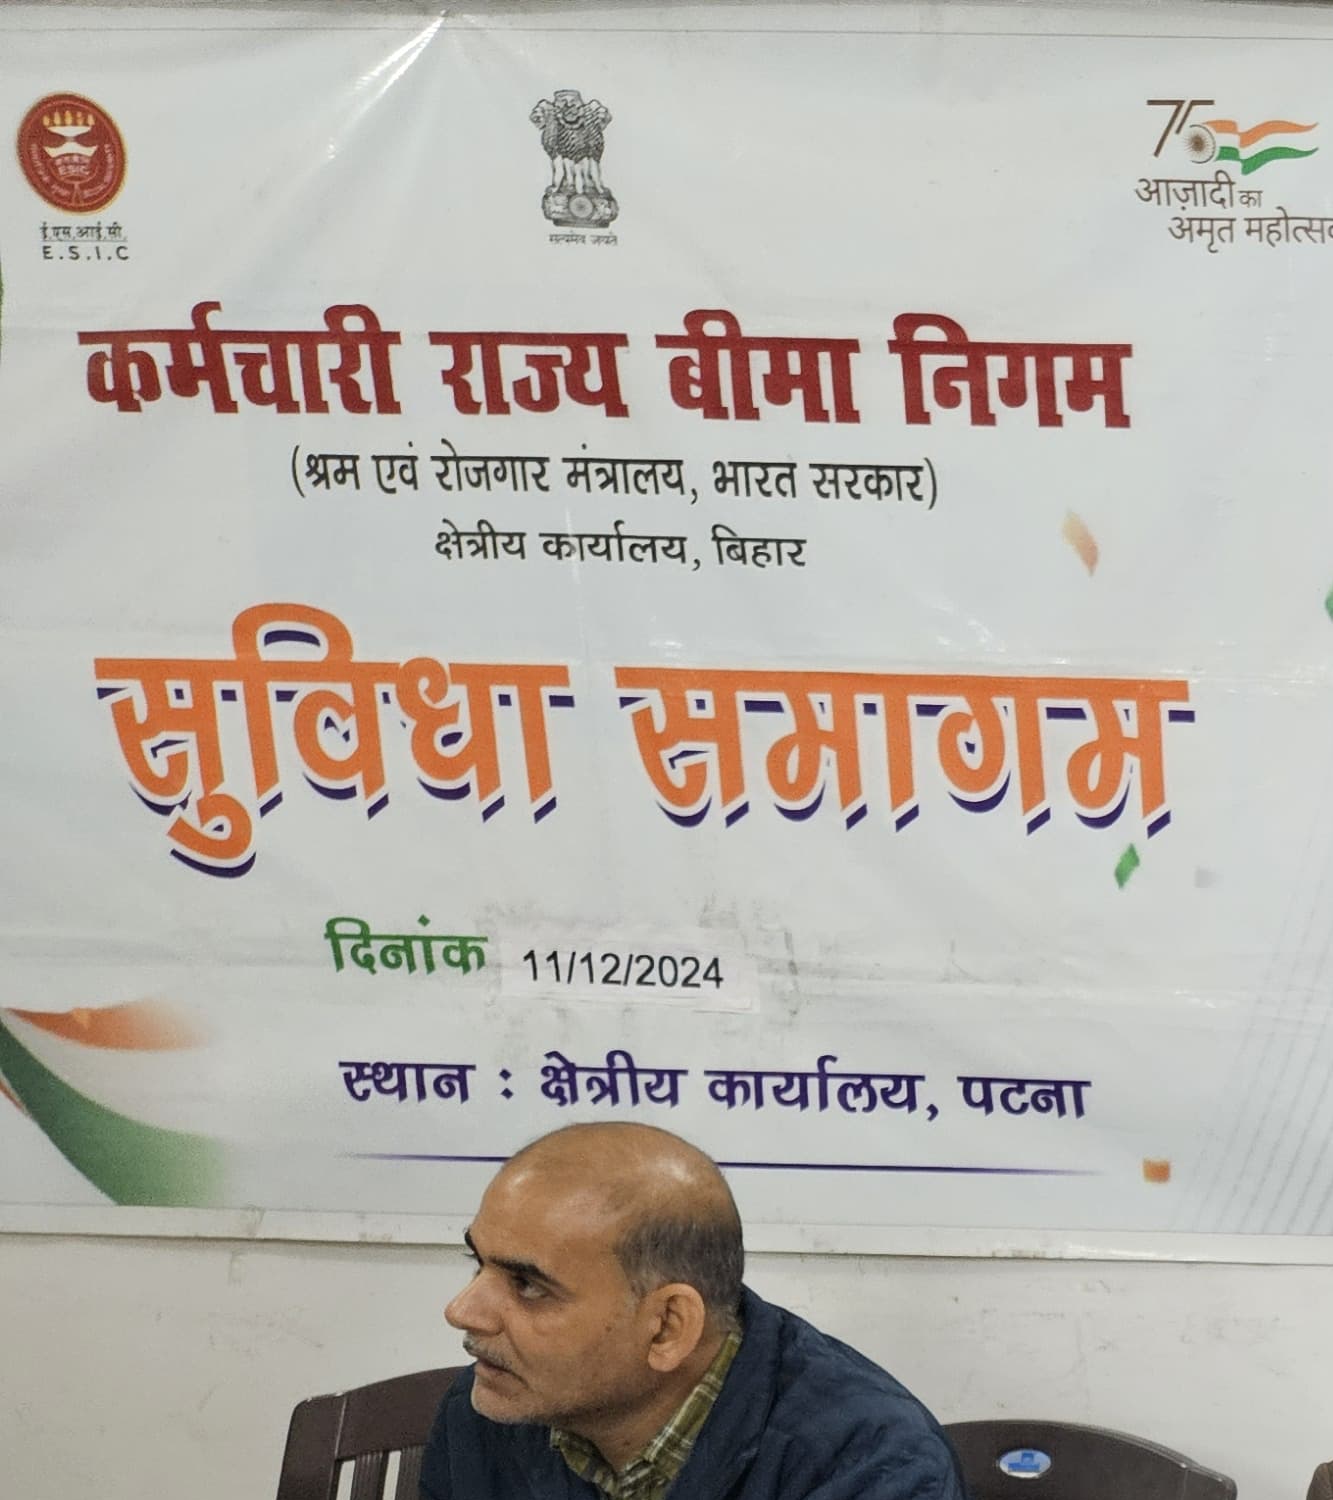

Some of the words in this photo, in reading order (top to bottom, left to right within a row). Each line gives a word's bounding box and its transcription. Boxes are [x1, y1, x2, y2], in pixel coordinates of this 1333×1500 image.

[1135, 170, 1235, 210] आज़ादी
[1238, 190, 1263, 208] का
[1168, 216, 1236, 253] अमृत
[78, 301, 401, 414] कर्मचारी
[428, 331, 629, 418] राज्य
[655, 309, 861, 424] बीमा
[887, 313, 1132, 428] निगम
[291, 444, 361, 498] (श्रम
[371, 441, 418, 495] एवं
[430, 438, 550, 493] रोजगार
[562, 443, 699, 505] मंत्रालय,
[712, 457, 797, 500] भारत
[809, 457, 938, 510] सरकार)
[435, 518, 526, 561] क्षेत्रीय
[539, 519, 702, 571] कार्यालय,
[711, 524, 807, 568] बिहार
[94, 603, 575, 878] सुविधा
[614, 666, 1195, 838] समागम
[324, 915, 489, 975] दिनांक
[523, 949, 725, 989] 11/12/2024
[339, 1056, 477, 1105] स्थान
[540, 1050, 688, 1109] क्षेत्रीय
[707, 1055, 939, 1122] कार्यालय,
[957, 1076, 1092, 1119] पटना
